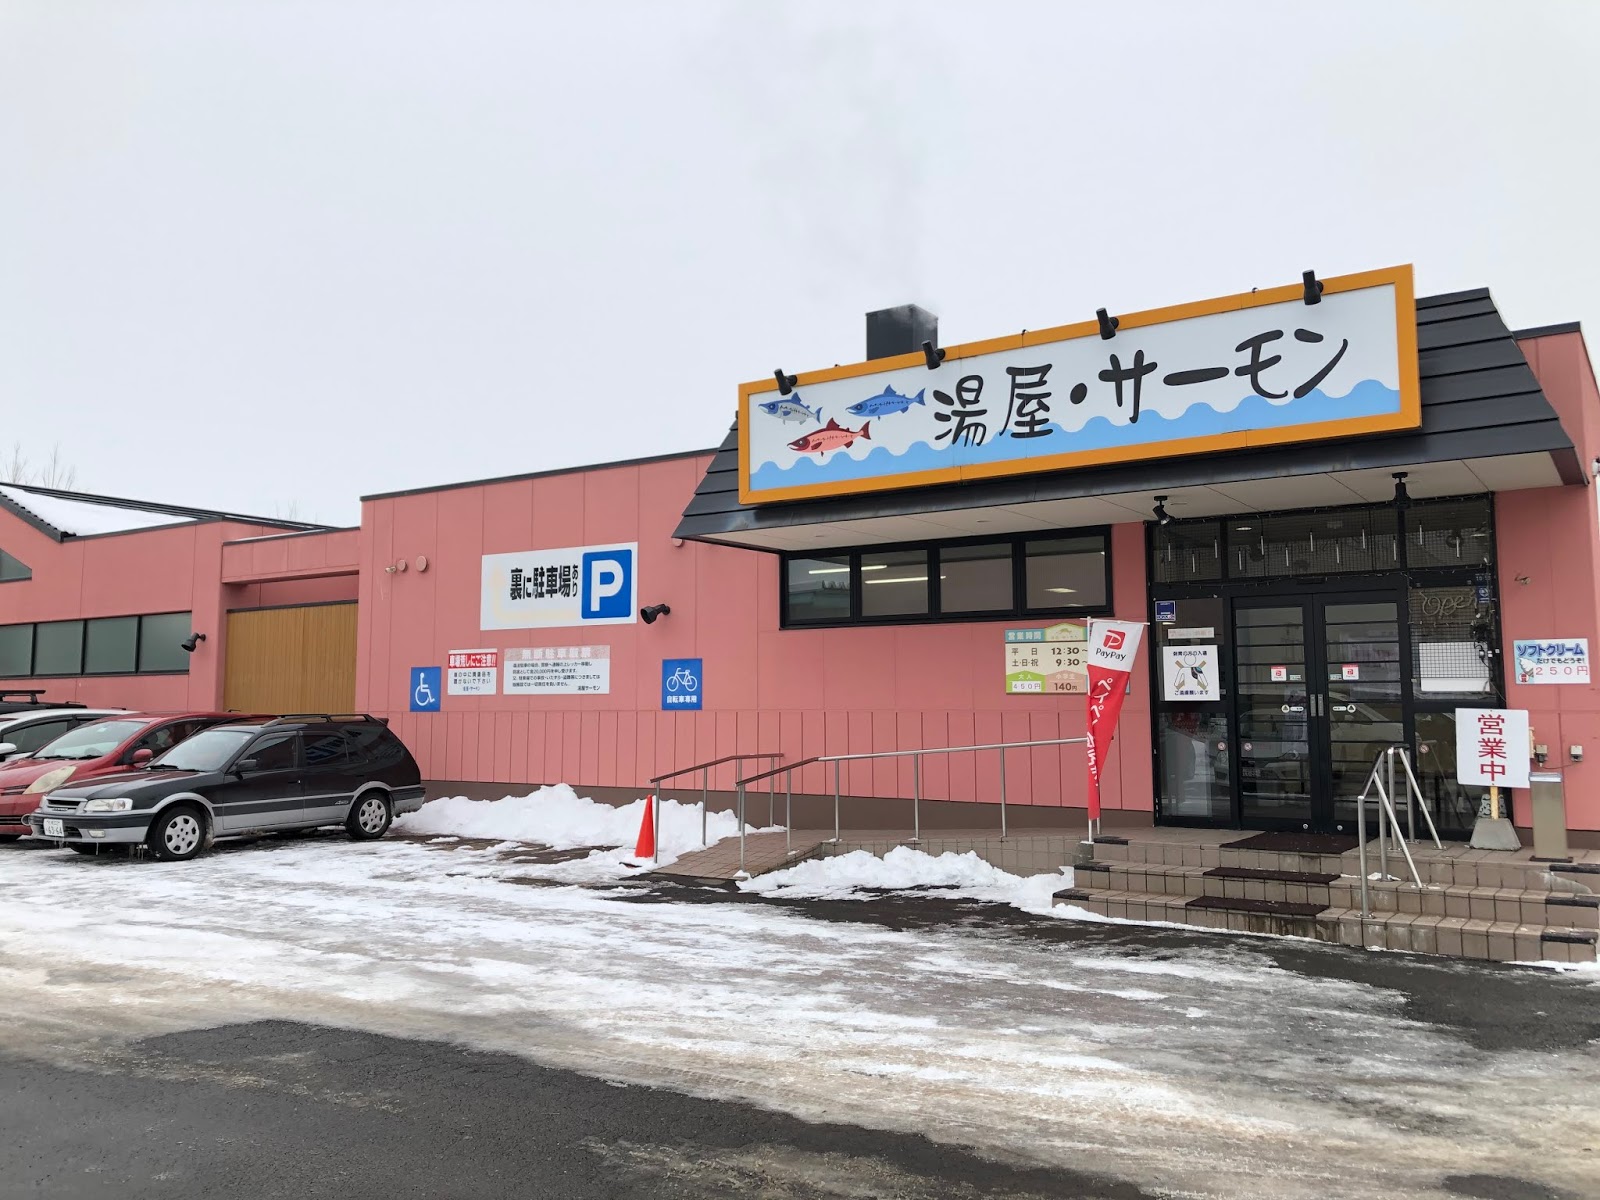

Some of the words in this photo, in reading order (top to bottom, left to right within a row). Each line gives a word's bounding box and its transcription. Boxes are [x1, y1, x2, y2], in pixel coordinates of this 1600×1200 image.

[932, 328, 1349, 447] 湯屋・サーモン
[591, 560, 624, 611] P
[1008, 631, 1042, 640] 営業時間
[1096, 648, 1127, 661] PayPay
[1517, 643, 1585, 657] ソフトクリーム
[1535, 666, 1588, 675] 250円
[1054, 682, 1077, 691] 140円
[667, 695, 697, 703] 自転車専用
[1477, 714, 1507, 782] 営業中
